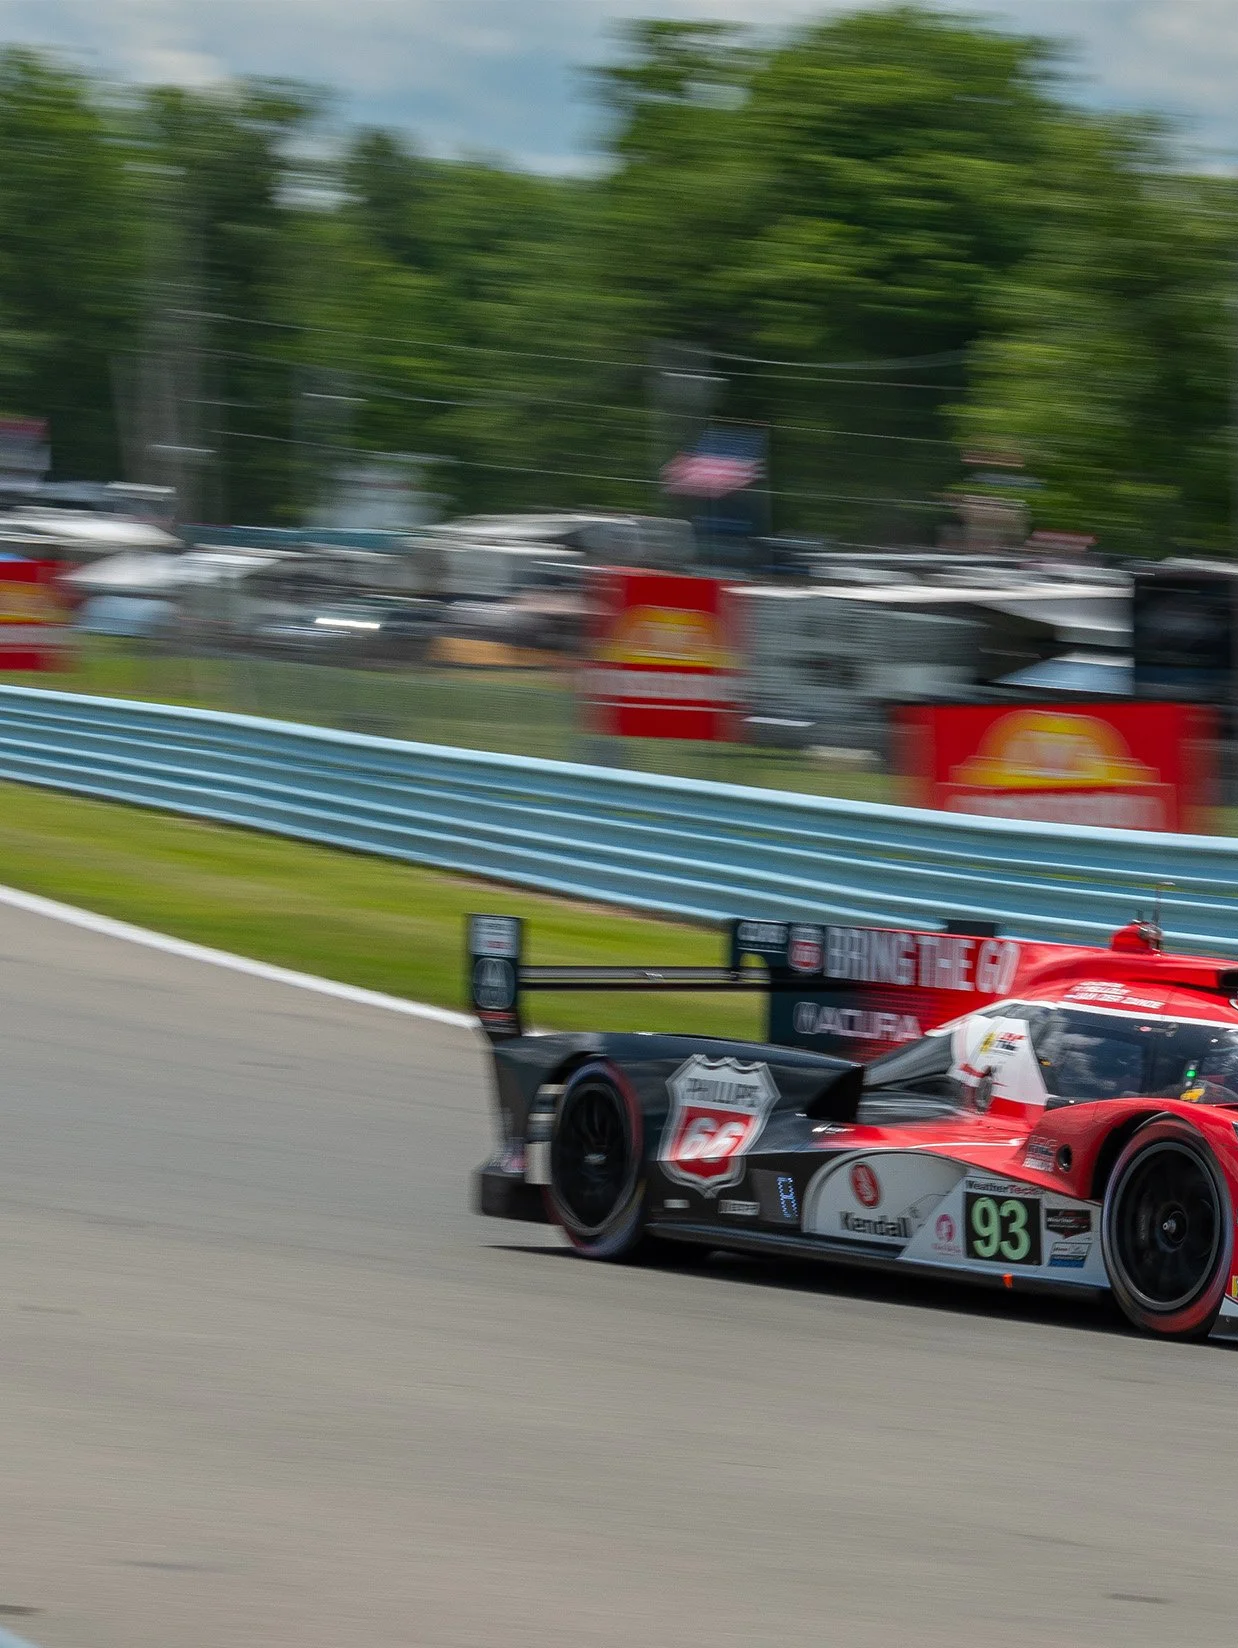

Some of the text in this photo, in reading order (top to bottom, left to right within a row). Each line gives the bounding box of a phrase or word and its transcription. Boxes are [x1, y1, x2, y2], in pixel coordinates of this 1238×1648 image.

[825, 926, 916, 985] BRING
[915, 935, 976, 992] THE
[976, 940, 1021, 995] GO
[814, 1006, 922, 1042] ACURA
[678, 1117, 746, 1163] 66
[841, 1211, 911, 1239] Kendall
[970, 1197, 1032, 1260] 93
